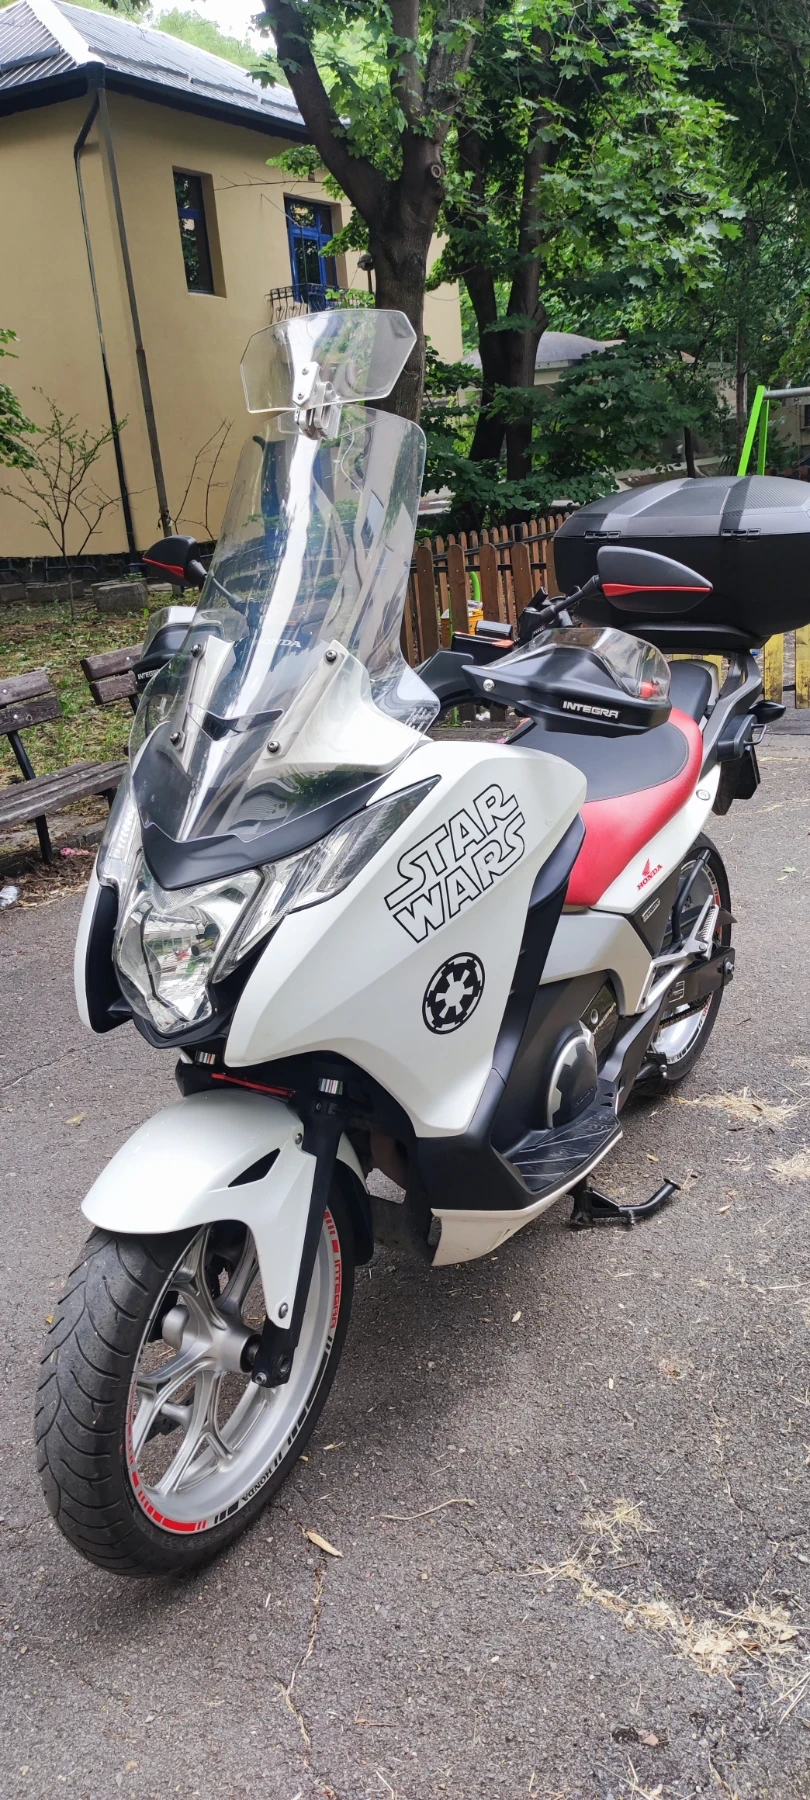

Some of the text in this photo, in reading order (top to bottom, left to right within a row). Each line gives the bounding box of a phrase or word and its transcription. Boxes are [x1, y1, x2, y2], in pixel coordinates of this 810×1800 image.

[562, 700, 619, 719] INTEGRA
[384, 783, 519, 911] STAR
[393, 811, 526, 944] WARS
[637, 864, 663, 890] HONDA
[592, 1002, 617, 1035] NTEGRA
[330, 1259, 341, 1329] INTEGRA
[241, 1466, 273, 1502] HONDA
